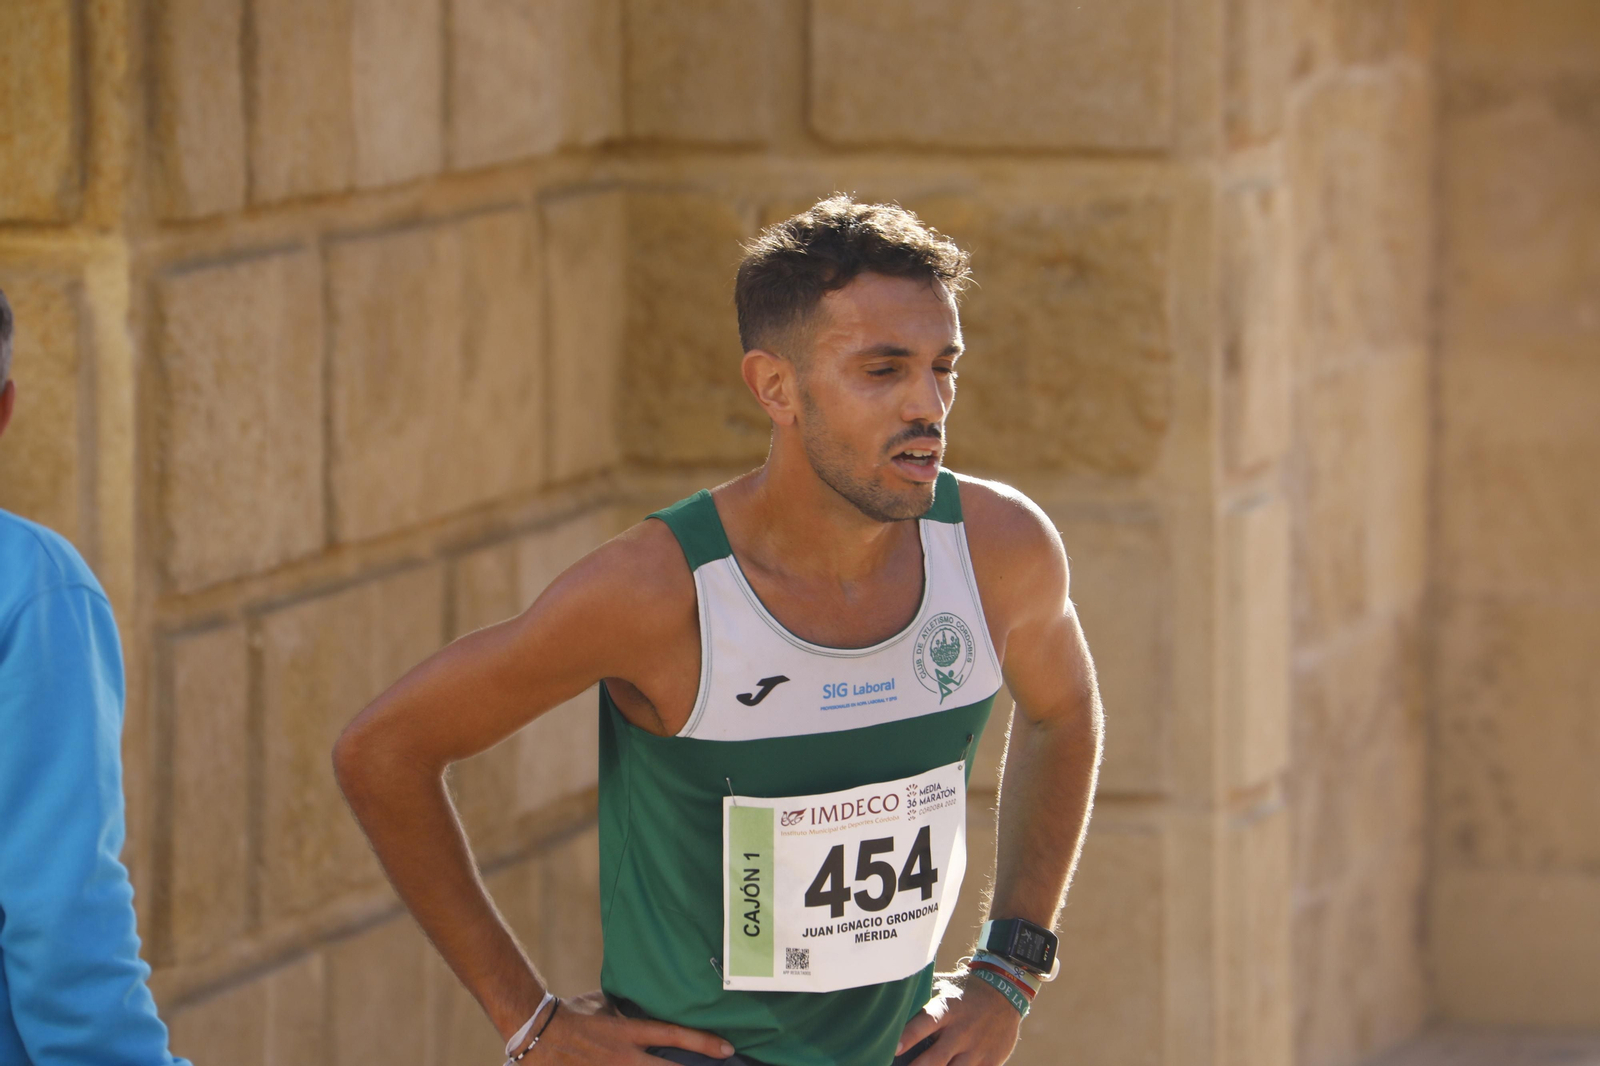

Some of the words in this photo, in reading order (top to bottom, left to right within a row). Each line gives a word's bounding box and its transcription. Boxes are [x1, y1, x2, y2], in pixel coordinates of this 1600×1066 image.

[921, 615, 954, 640] ATLETISMO
[915, 642, 924, 655] DE
[915, 658, 927, 680] CLUB
[822, 682, 848, 699] SIG
[853, 677, 895, 696] Laboral
[919, 782, 942, 796] MEDIA
[919, 786, 956, 806] MARATÓN
[810, 793, 900, 825] IMDECO
[906, 798, 918, 809] 36
[808, 826, 839, 836] Municipal
[847, 819, 874, 829] Deportes
[874, 815, 900, 824] Córdoba
[743, 853, 760, 861] 1
[804, 824, 938, 919] 454
[739, 868, 761, 938] CAJÓN
[802, 925, 834, 938] JUAN
[837, 916, 883, 933] IGNACIO
[886, 902, 939, 926] GRONDONA
[854, 928, 898, 944] MÉRIDA
[997, 979, 1013, 997] DE
[1012, 992, 1024, 1009] LA
